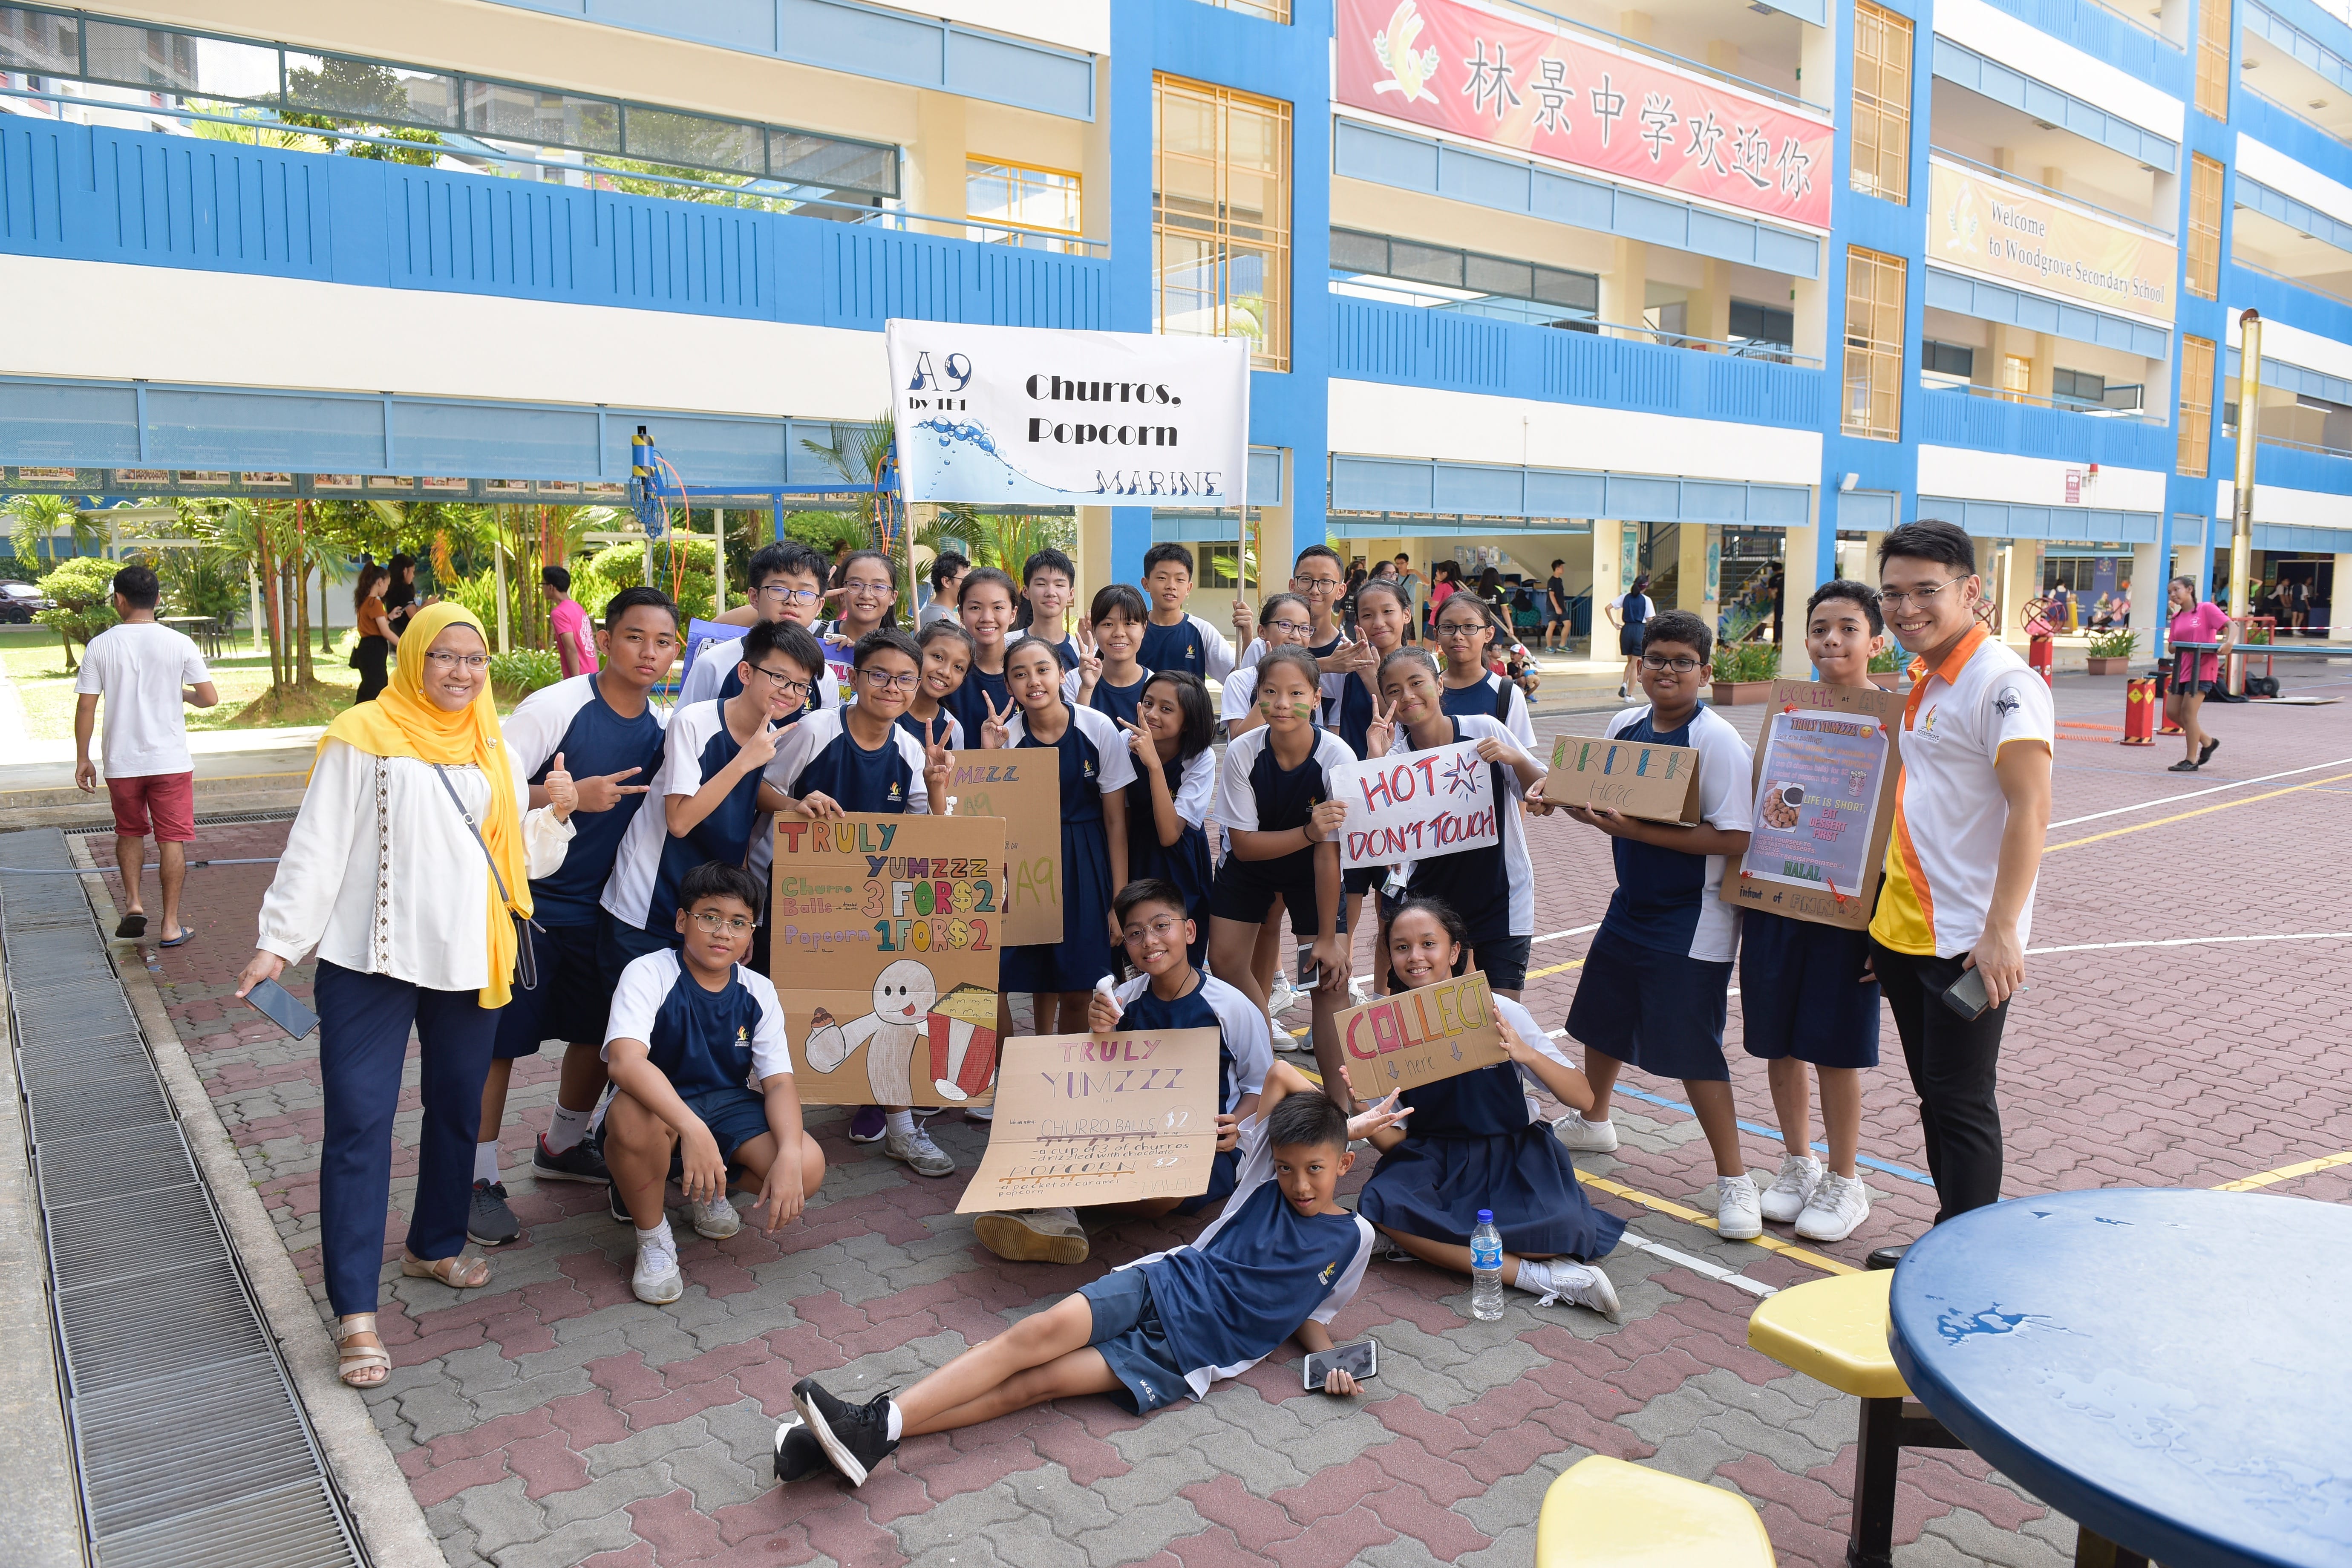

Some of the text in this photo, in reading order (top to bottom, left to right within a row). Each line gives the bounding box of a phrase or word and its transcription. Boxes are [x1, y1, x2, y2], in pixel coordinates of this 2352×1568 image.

[1463, 37, 1812, 200] 林景中学欢迎你
[1991, 200, 2045, 237] Welcome
[1989, 236, 2165, 303] to Woodgrove Secondary School
[906, 351, 972, 392] A9
[1026, 374, 1182, 408] Churros,
[909, 396, 966, 411] by 1E1
[1028, 418, 1178, 446] Popcorn
[1095, 470, 1222, 496] MARINE
[1780, 685, 1837, 707] BOOTH
[1792, 718, 1859, 736] TRULY YUMZZZ!
[1554, 740, 1687, 779] ORDER
[1830, 766, 1839, 775] for
[1359, 754, 1440, 815] HOT
[1803, 795, 1866, 814] LIFE IS SHORT,
[1822, 808, 1838, 820] EAT
[1347, 804, 1496, 861] DON'T TOUCH
[1809, 817, 1848, 832] DESSERT
[1813, 829, 1838, 842] FIRST
[778, 821, 897, 853] TRULY
[865, 856, 988, 879] YUMZZZ
[1782, 861, 1821, 882] HALAL
[782, 877, 852, 897] Churro
[1016, 856, 1056, 907] A9
[784, 898, 832, 916] Balls
[861, 880, 884, 918] 3
[1773, 891, 1782, 904] of
[1790, 894, 1835, 917] FNN
[1850, 906, 1860, 919] 2
[785, 925, 870, 949] Popcorn
[1346, 977, 1488, 1060] COLLECT
[1057, 1040, 1162, 1062] TRULY
[1405, 1056, 1435, 1078] here
[1041, 1068, 1185, 1098] YUMZZZ
[1041, 1111, 1188, 1137] CHURRO BALLS $2
[1051, 1146, 1078, 1157] cup
[1115, 1143, 1130, 1151] of
[1134, 1141, 1189, 1150] churros
[1123, 1149, 1174, 1157] chocolate
[1009, 1157, 1178, 1178] POPCORN $2
[999, 1189, 1043, 1198] popcorn
[1013, 1182, 1055, 1191] packet
[1060, 1180, 1073, 1188] of
[1075, 1178, 1118, 1186] caramel
